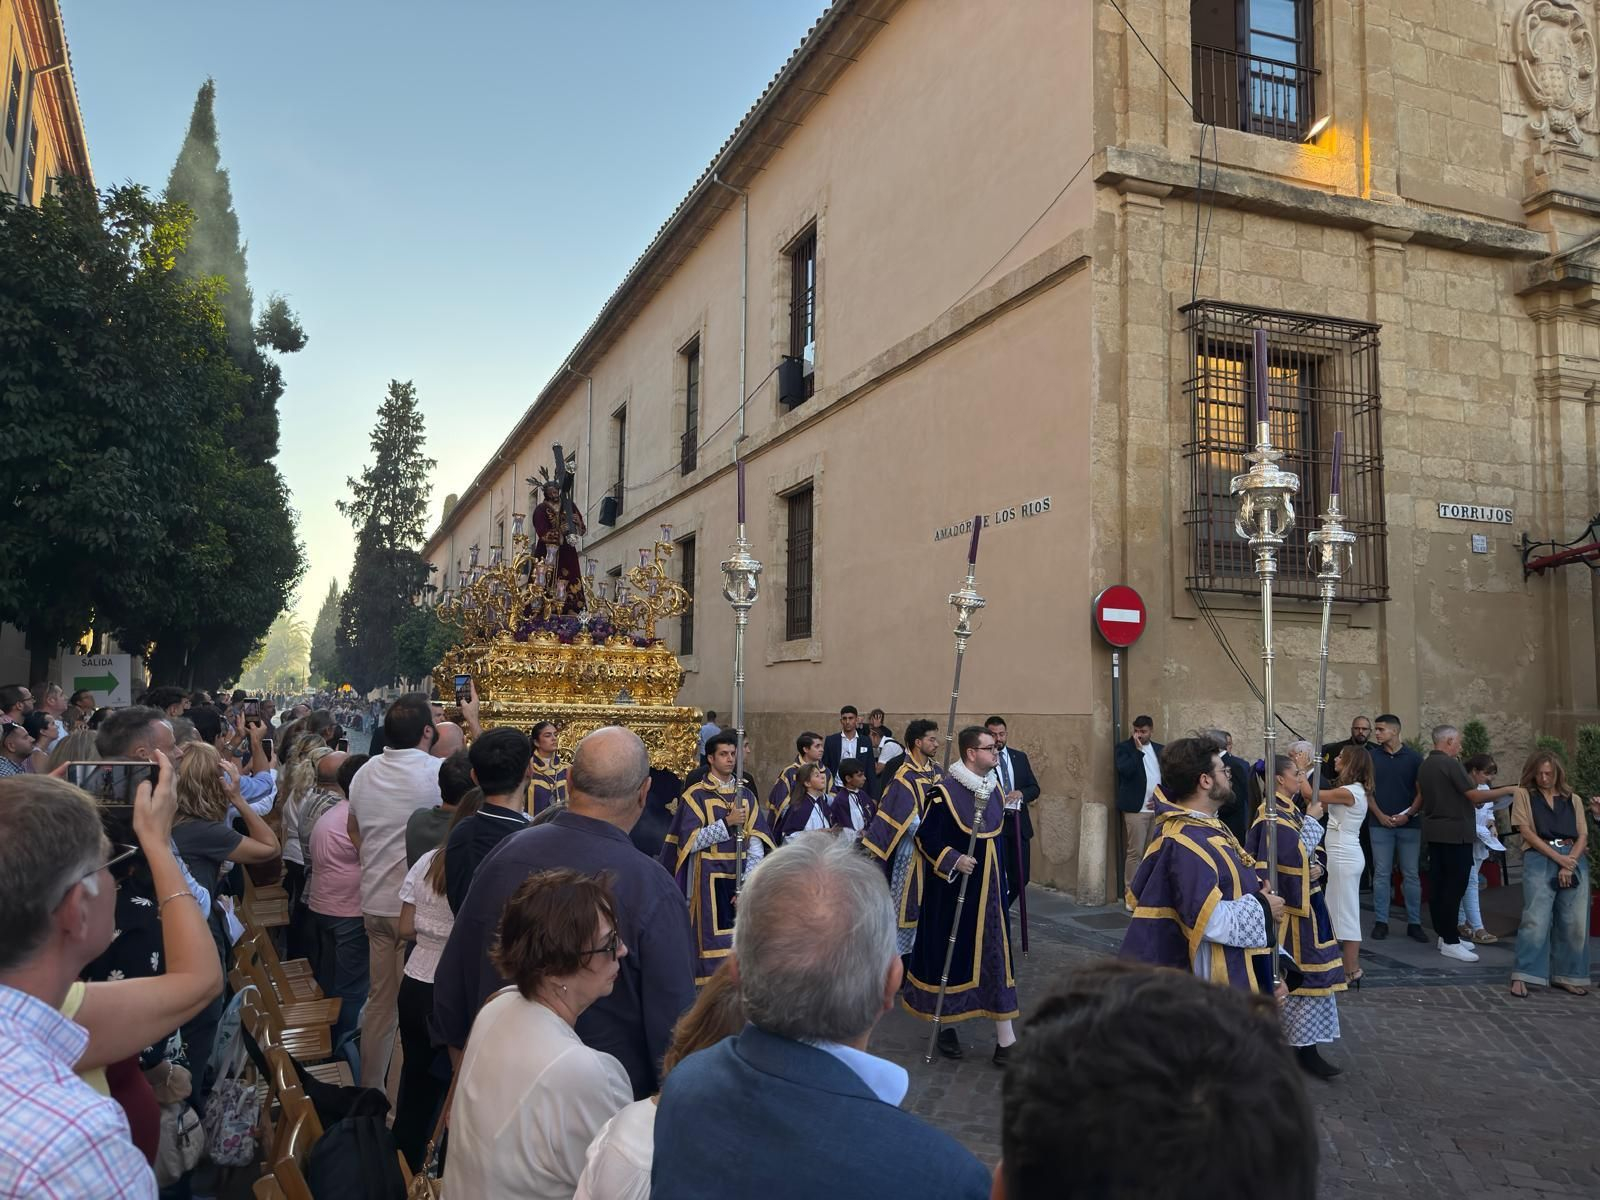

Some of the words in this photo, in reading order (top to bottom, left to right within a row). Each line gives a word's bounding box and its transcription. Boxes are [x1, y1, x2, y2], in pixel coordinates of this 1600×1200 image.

[934, 521, 972, 541] AMADOR
[995, 507, 1016, 524] LOS
[1021, 497, 1050, 518] RIOS
[1440, 504, 1513, 522] TORRIJOS
[81, 658, 113, 667] SALIDA
